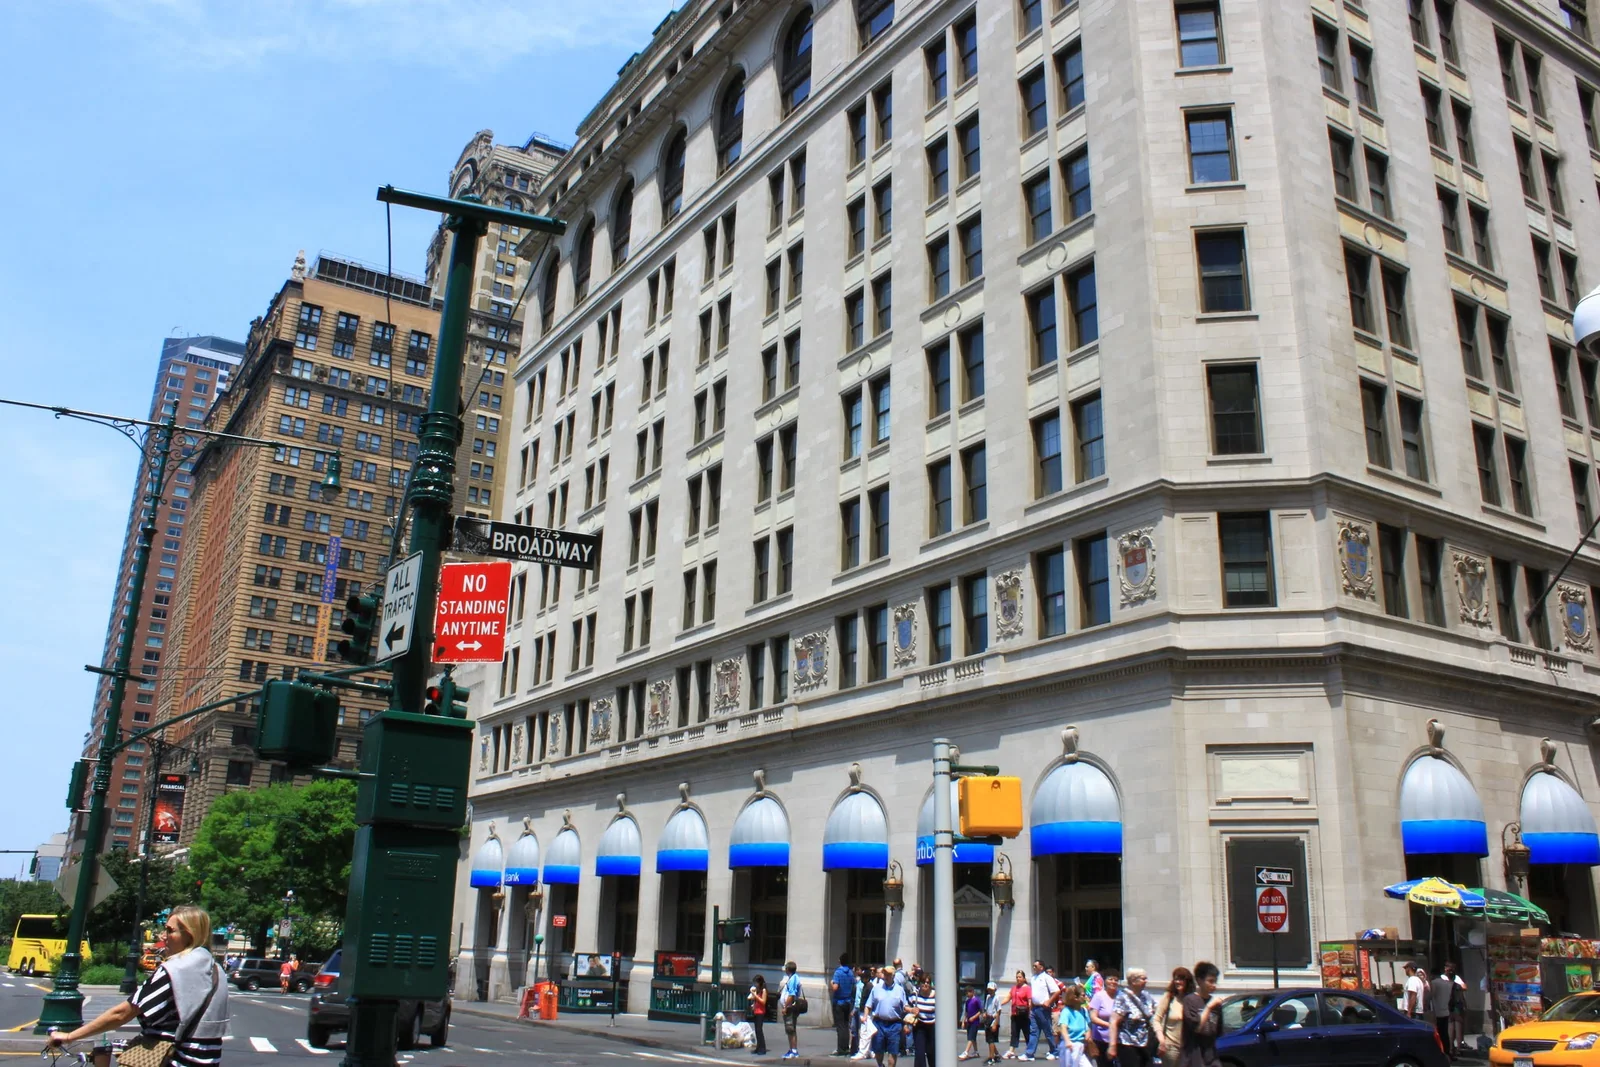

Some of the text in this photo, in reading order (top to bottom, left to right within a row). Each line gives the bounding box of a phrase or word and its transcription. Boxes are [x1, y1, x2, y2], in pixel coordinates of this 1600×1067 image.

[492, 531, 593, 563] BROADWAY
[518, 554, 537, 562] CANYON
[391, 566, 411, 594] ALL
[462, 574, 487, 593] NO
[384, 591, 414, 621] TRAFFIC
[439, 600, 506, 615] STANDING
[441, 621, 500, 636] ANYTIME
[1261, 872, 1273, 880] ONE
[1261, 896, 1282, 904] DO NOT
[1264, 915, 1282, 923] ENTER
